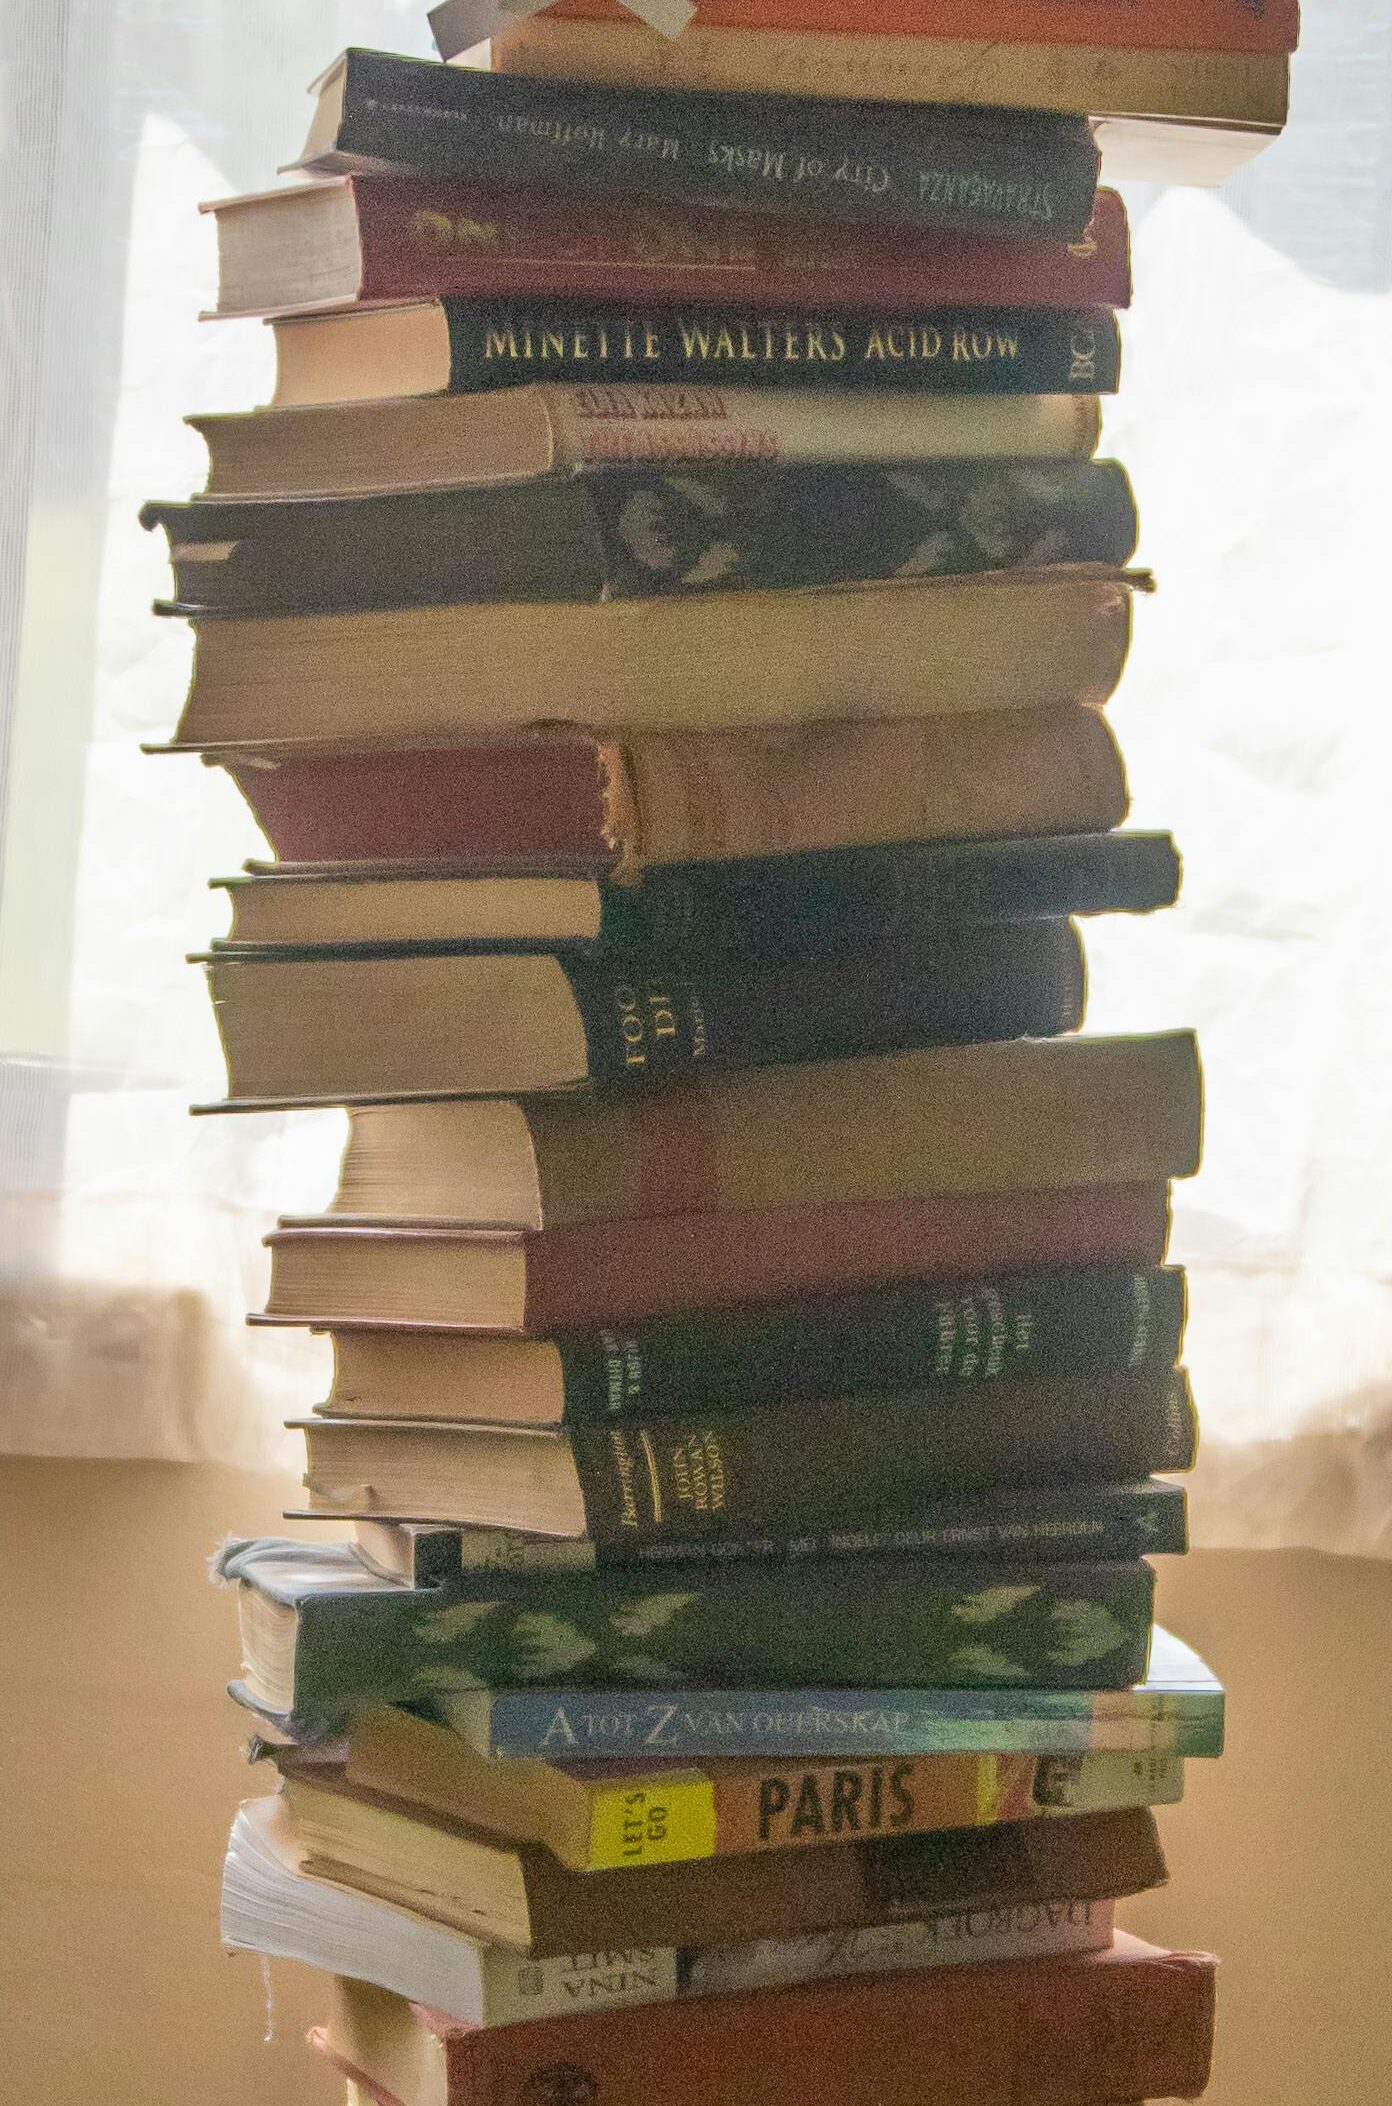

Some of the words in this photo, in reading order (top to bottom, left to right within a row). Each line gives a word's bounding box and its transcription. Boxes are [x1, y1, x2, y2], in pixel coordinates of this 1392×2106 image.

[498, 115, 605, 151] Hoffman
[619, 127, 679, 162] Mary
[709, 140, 785, 181] Masks
[794, 155, 823, 183] of
[834, 155, 890, 194] City
[919, 171, 1053, 221] STRAVAGANZA
[484, 320, 661, 360] MINETTE
[680, 317, 847, 362] WALTERS
[864, 325, 942, 360] ACID
[951, 326, 1018, 361] ROW
[672, 1443, 693, 1501] JOHN
[687, 1431, 708, 1510] ROWAN
[701, 1428, 726, 1512] WILSON
[540, 1705, 581, 1748] A
[581, 1712, 638, 1737] TOT
[643, 1704, 680, 1746] Z
[684, 1711, 747, 1735] VAN
[647, 1805, 668, 1840] GO
[757, 1762, 917, 1841] PARIS
[623, 1791, 646, 1857] LET'S
[561, 1967, 659, 1999] NINA
